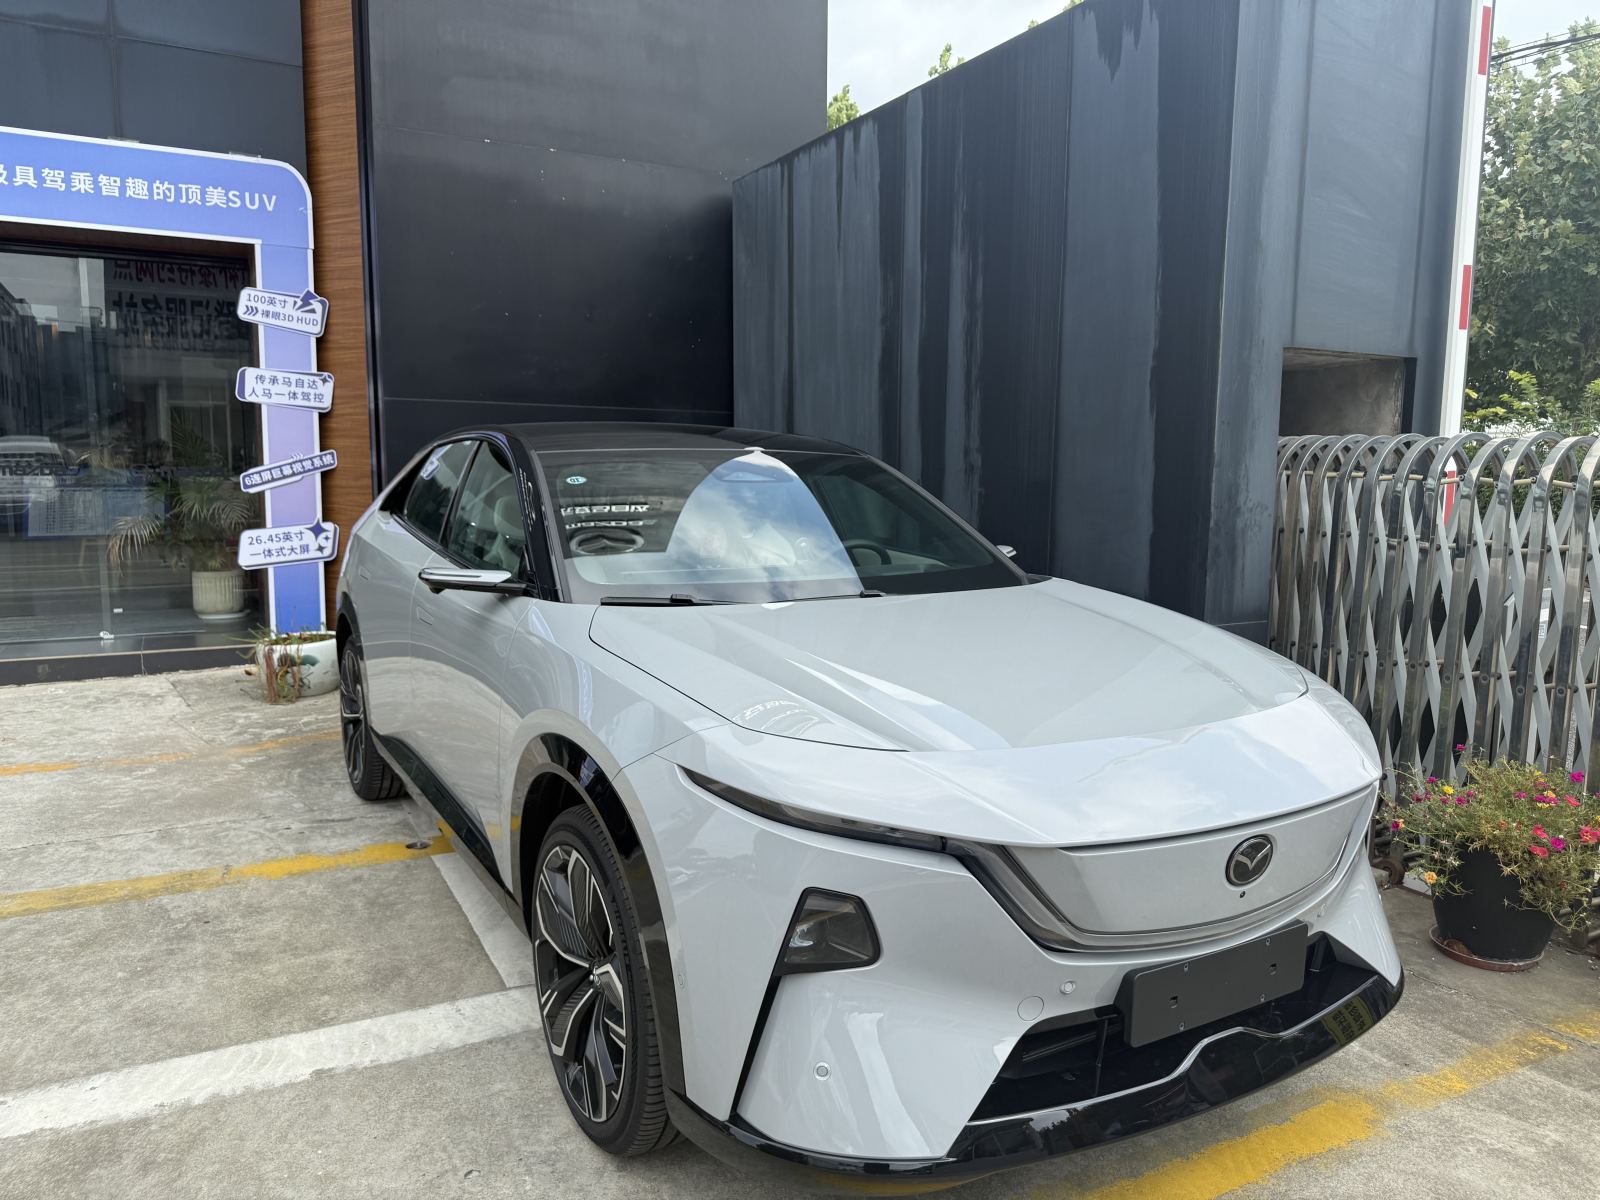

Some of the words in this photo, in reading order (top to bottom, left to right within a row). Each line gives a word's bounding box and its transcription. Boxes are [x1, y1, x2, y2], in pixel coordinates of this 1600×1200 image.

[247, 293, 288, 309] 100英寸
[261, 309, 294, 322] 裸眼3D
[296, 316, 319, 327] HUD
[255, 374, 318, 390] 传承马自达
[248, 386, 325, 403] 人马一体驾控
[248, 531, 305, 546] 26.45英寸
[249, 543, 310, 559] 一体式大屏
